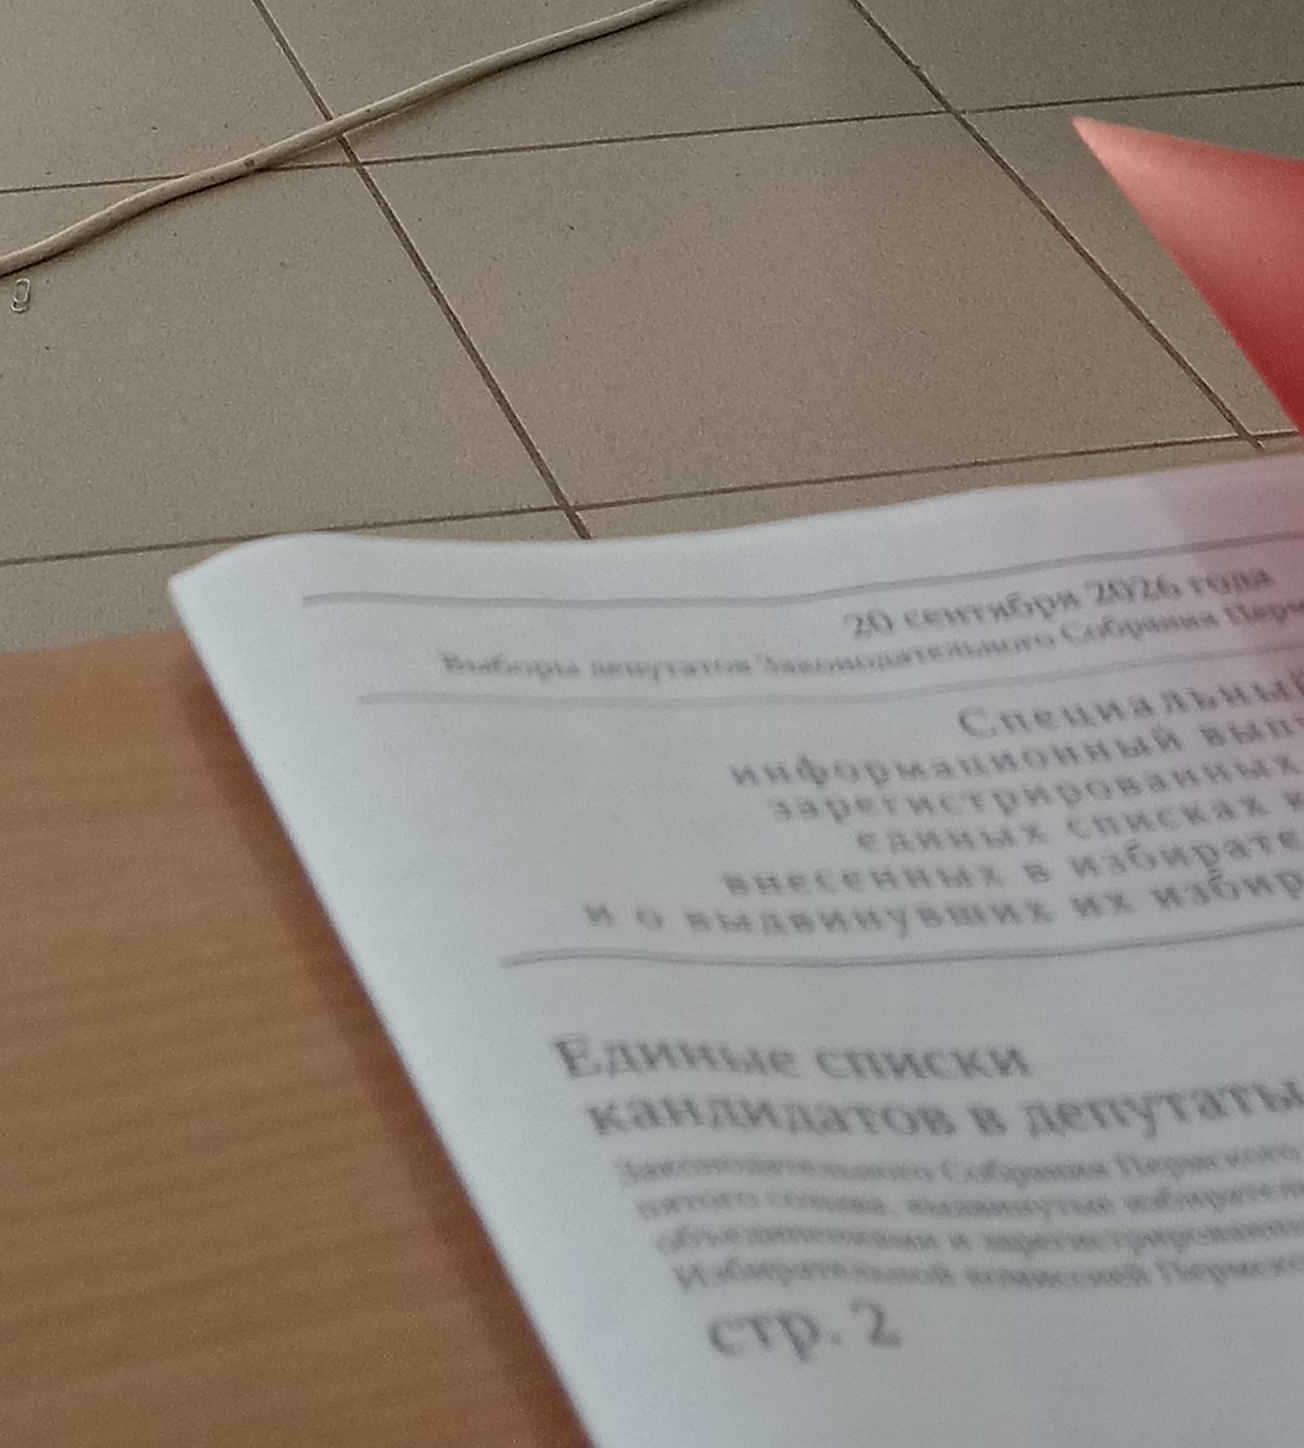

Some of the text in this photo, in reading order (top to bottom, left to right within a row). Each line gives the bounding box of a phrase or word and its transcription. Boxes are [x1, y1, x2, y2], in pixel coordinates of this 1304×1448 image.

[845, 567, 1275, 640] 20 сентября 2026 года
[1224, 599, 1304, 627] Перм
[730, 710, 1304, 789] информационный вып
[768, 754, 1300, 825] зарегистрированных
[856, 823, 1048, 855] единых
[1066, 794, 1269, 839] списках
[723, 828, 1304, 895] внесенных в избирате
[684, 899, 1053, 940] выдвинувших
[1068, 889, 1133, 917] их
[1149, 866, 1304, 909] избир
[553, 1034, 1033, 1081] Единые списки
[588, 1077, 1304, 1141] кандидатов в депутаты
[708, 1297, 902, 1361] стр. 2
